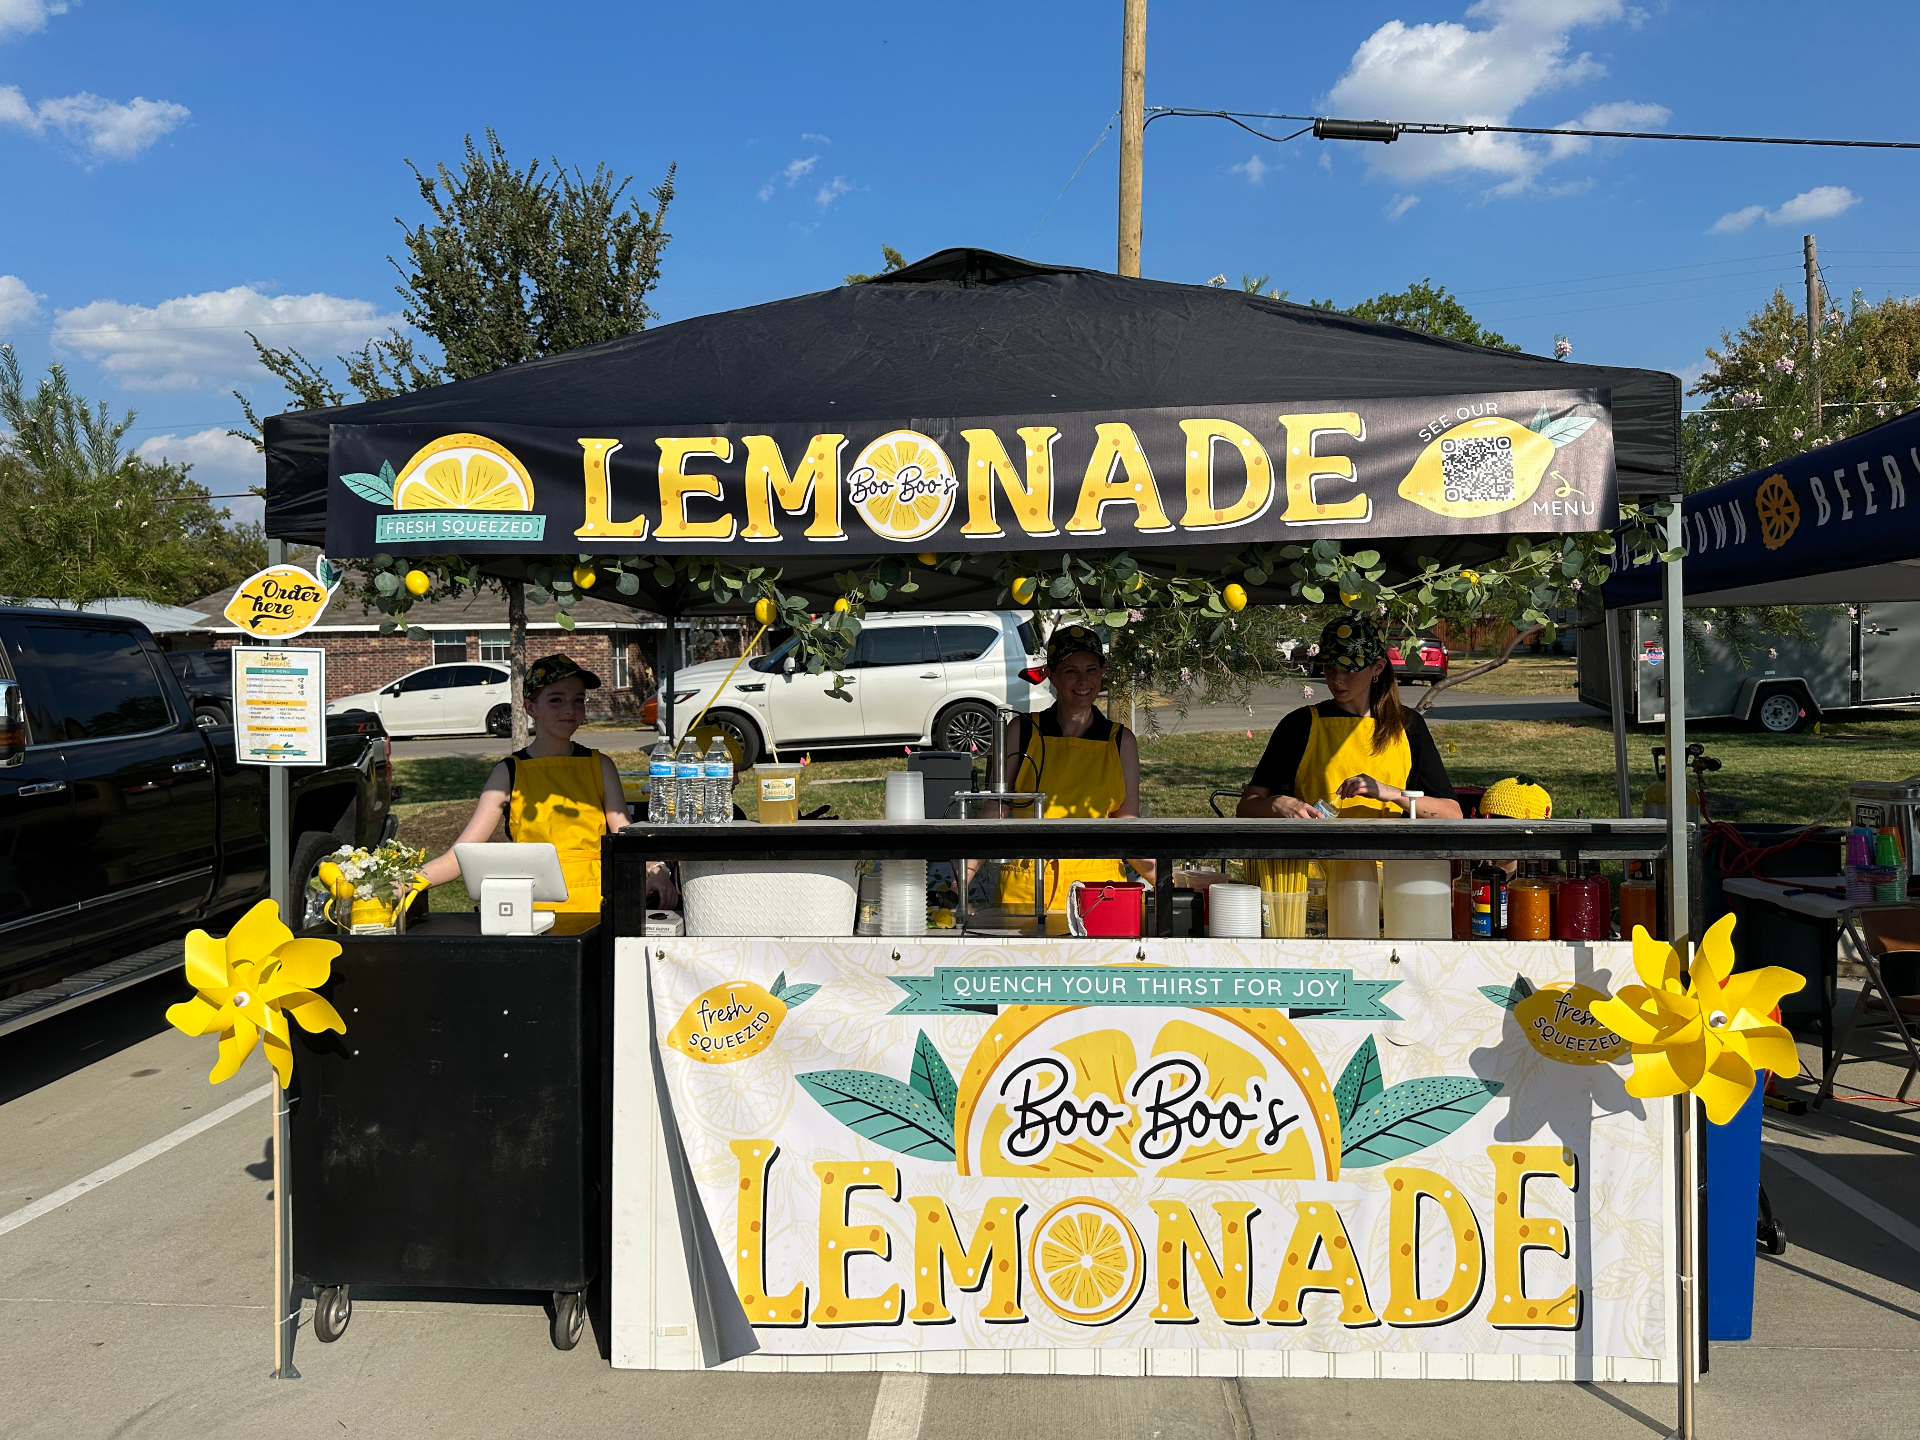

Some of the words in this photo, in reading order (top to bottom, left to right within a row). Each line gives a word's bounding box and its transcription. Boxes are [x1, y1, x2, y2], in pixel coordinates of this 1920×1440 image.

[1418, 414, 1452, 443] SEE
[1456, 402, 1499, 421] OUR
[576, 411, 1373, 543] LEMONADE
[849, 466, 895, 504] Boo
[896, 465, 957, 503] Boo's
[1809, 447, 1920, 527] BEER
[386, 520, 436, 535] FRESH
[442, 519, 533, 535] SQUEEZED
[1533, 500, 1596, 517] MENU
[241, 593, 295, 615] here
[262, 579, 323, 603] Order
[953, 975, 1052, 996] QUENCH
[1060, 975, 1128, 995] YOUR
[1136, 976, 1223, 996] THIRST
[1233, 977, 1283, 997] FOR
[1292, 978, 1341, 998] JOY
[688, 1010, 771, 1054] SQUEEZED
[696, 992, 754, 1033] fresh
[1533, 1017, 1622, 1052] SQUEEZED
[1000, 1057, 1124, 1160] Boo
[1132, 1057, 1300, 1160] Boo's
[728, 1139, 1584, 1330] LEMONADE
